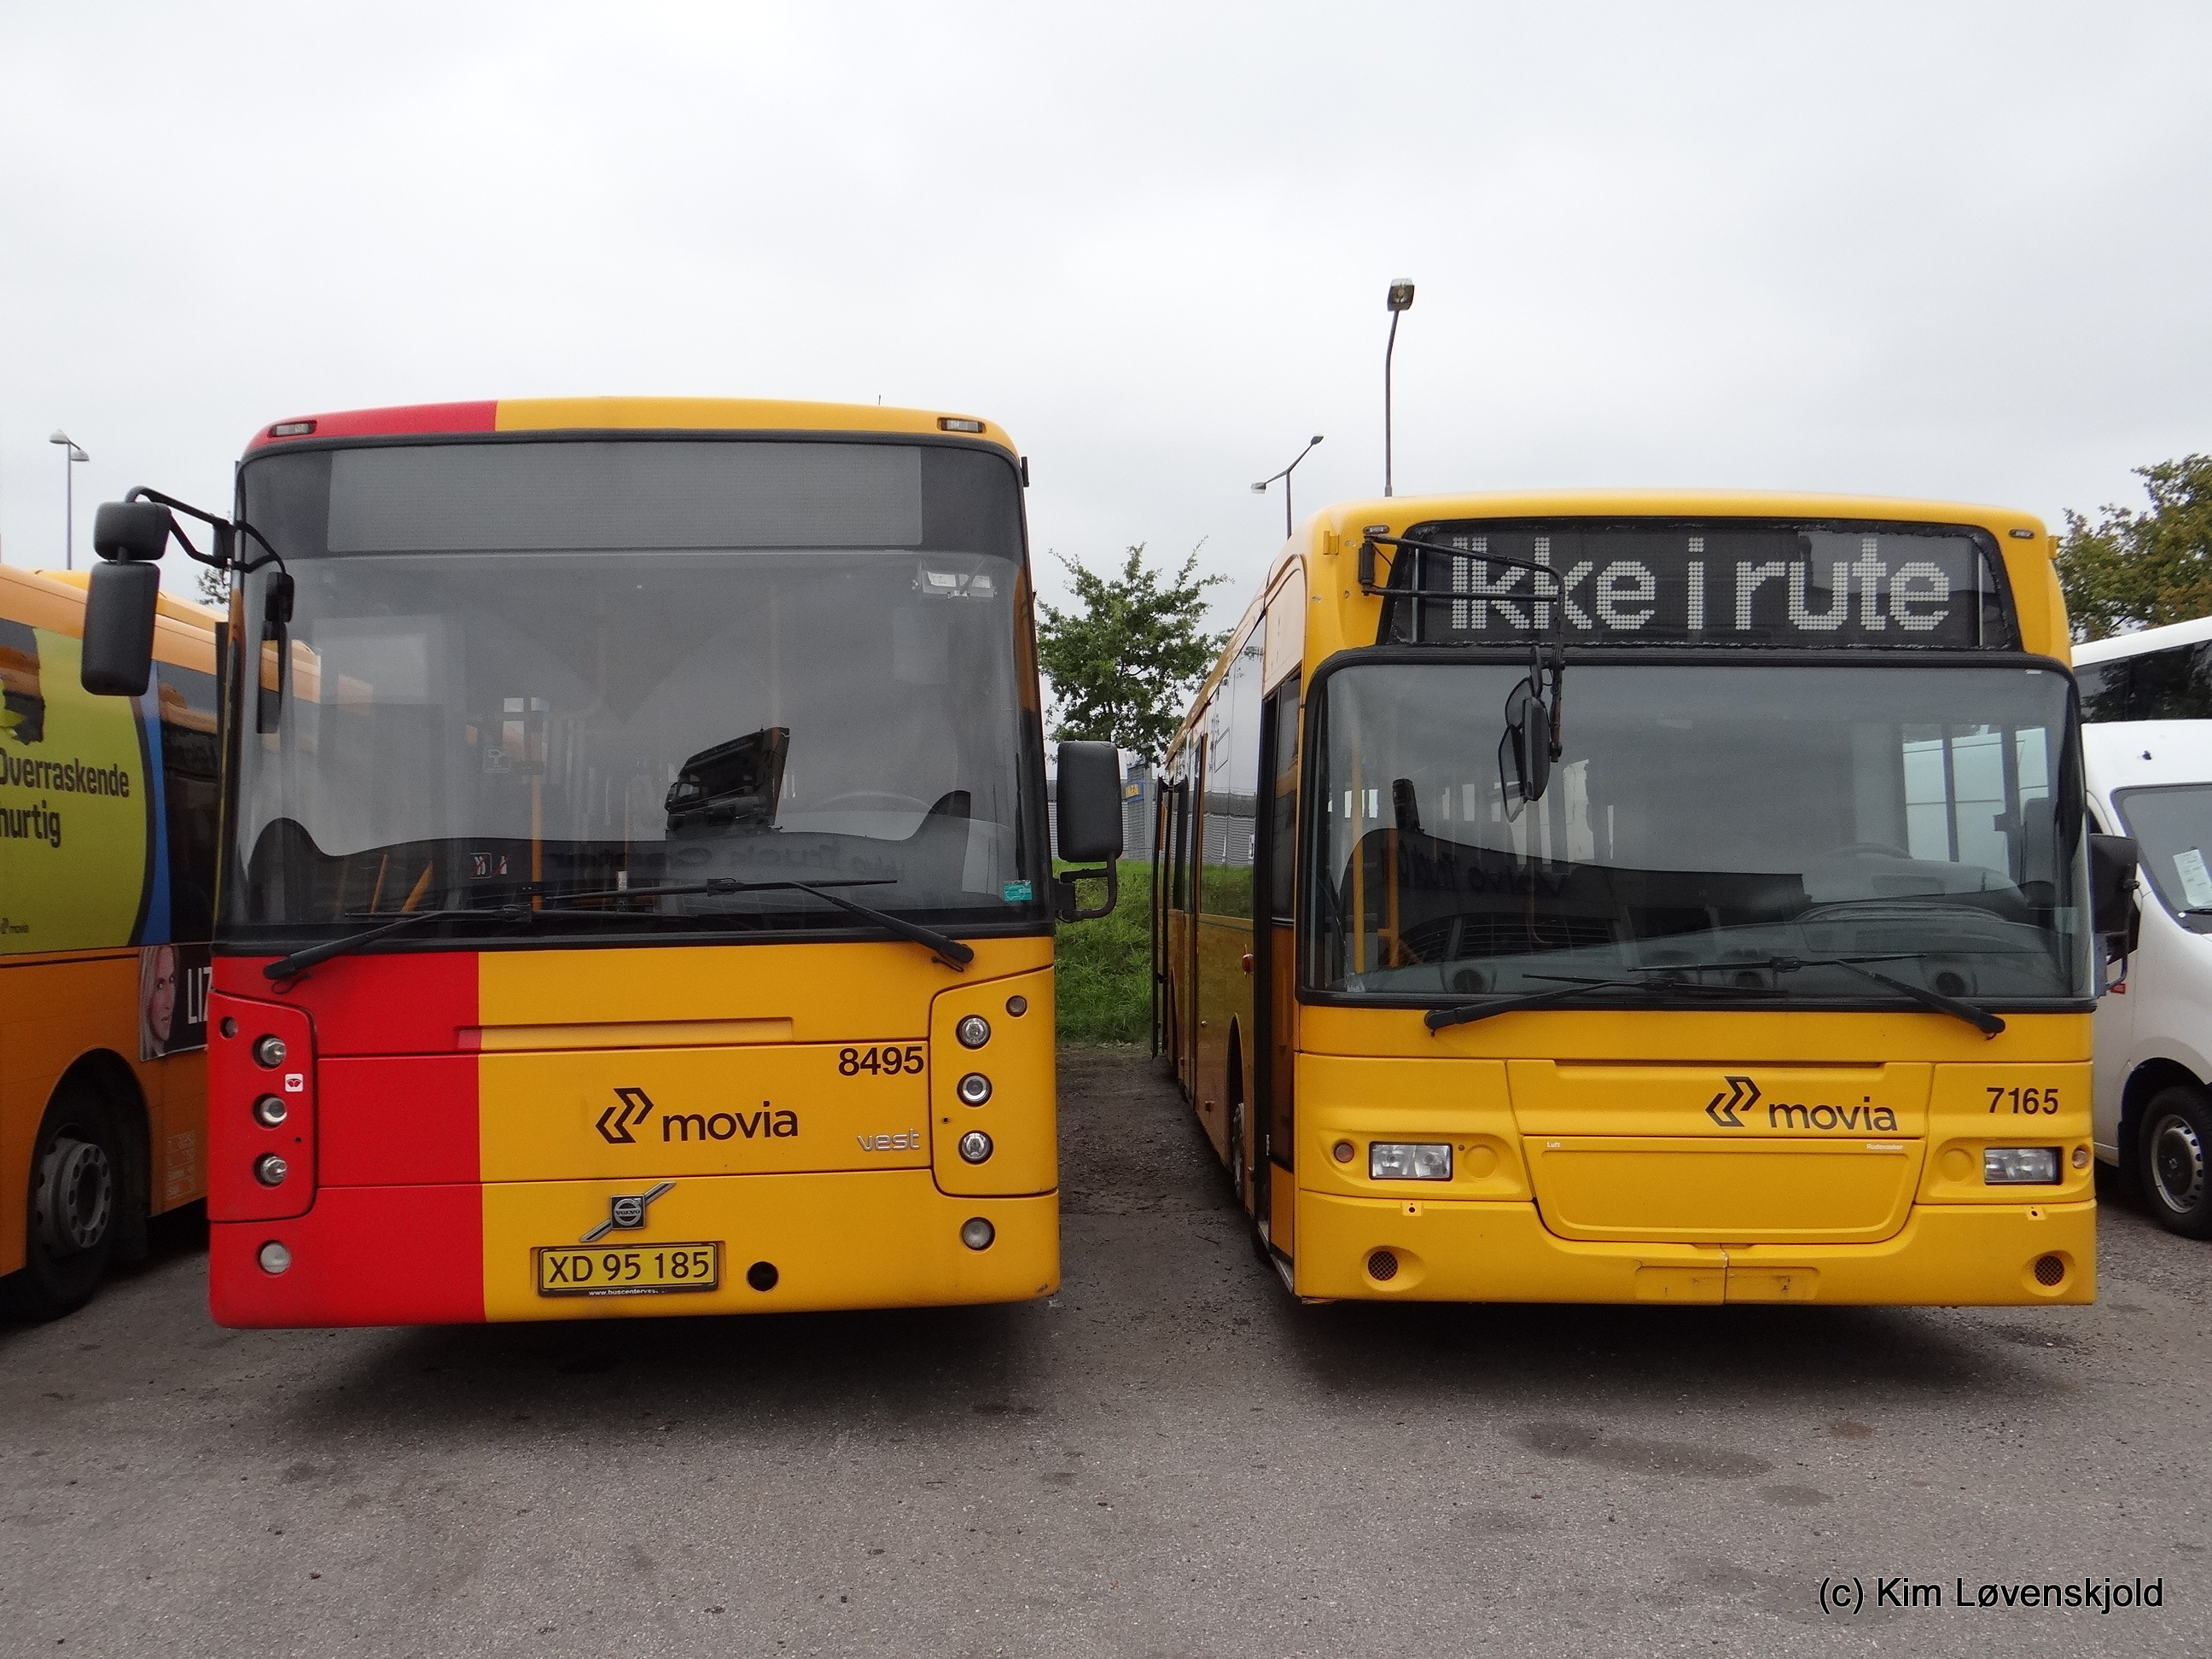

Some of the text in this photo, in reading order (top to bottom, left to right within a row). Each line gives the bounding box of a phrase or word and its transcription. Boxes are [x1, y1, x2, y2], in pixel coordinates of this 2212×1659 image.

[1452, 537, 1949, 631] Ikke i rute
[838, 1045, 924, 1076] 8495
[1768, 1097, 1898, 1132] movia
[1986, 1086, 2059, 1115] 7165
[663, 1101, 798, 1142] movia
[857, 1128, 921, 1151] vest
[549, 1251, 709, 1283] XD 95 185
